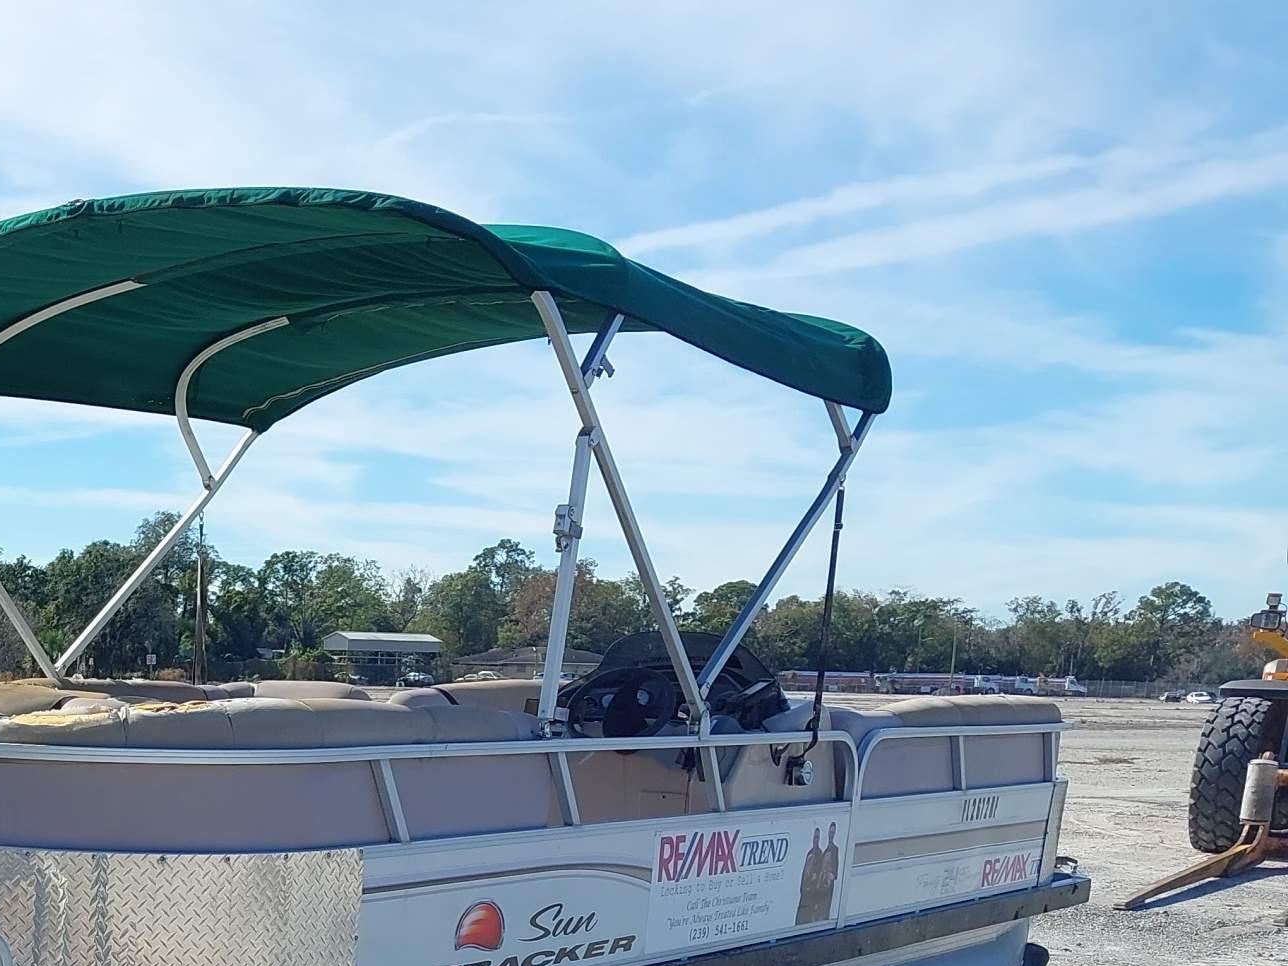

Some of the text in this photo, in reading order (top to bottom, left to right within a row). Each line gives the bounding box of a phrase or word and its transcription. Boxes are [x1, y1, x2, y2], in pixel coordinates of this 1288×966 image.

[657, 829, 789, 882] RE/MAX TREND
[980, 853, 1031, 887] RE/MAX
[518, 903, 598, 942] Sun
[689, 926, 710, 942] (239)
